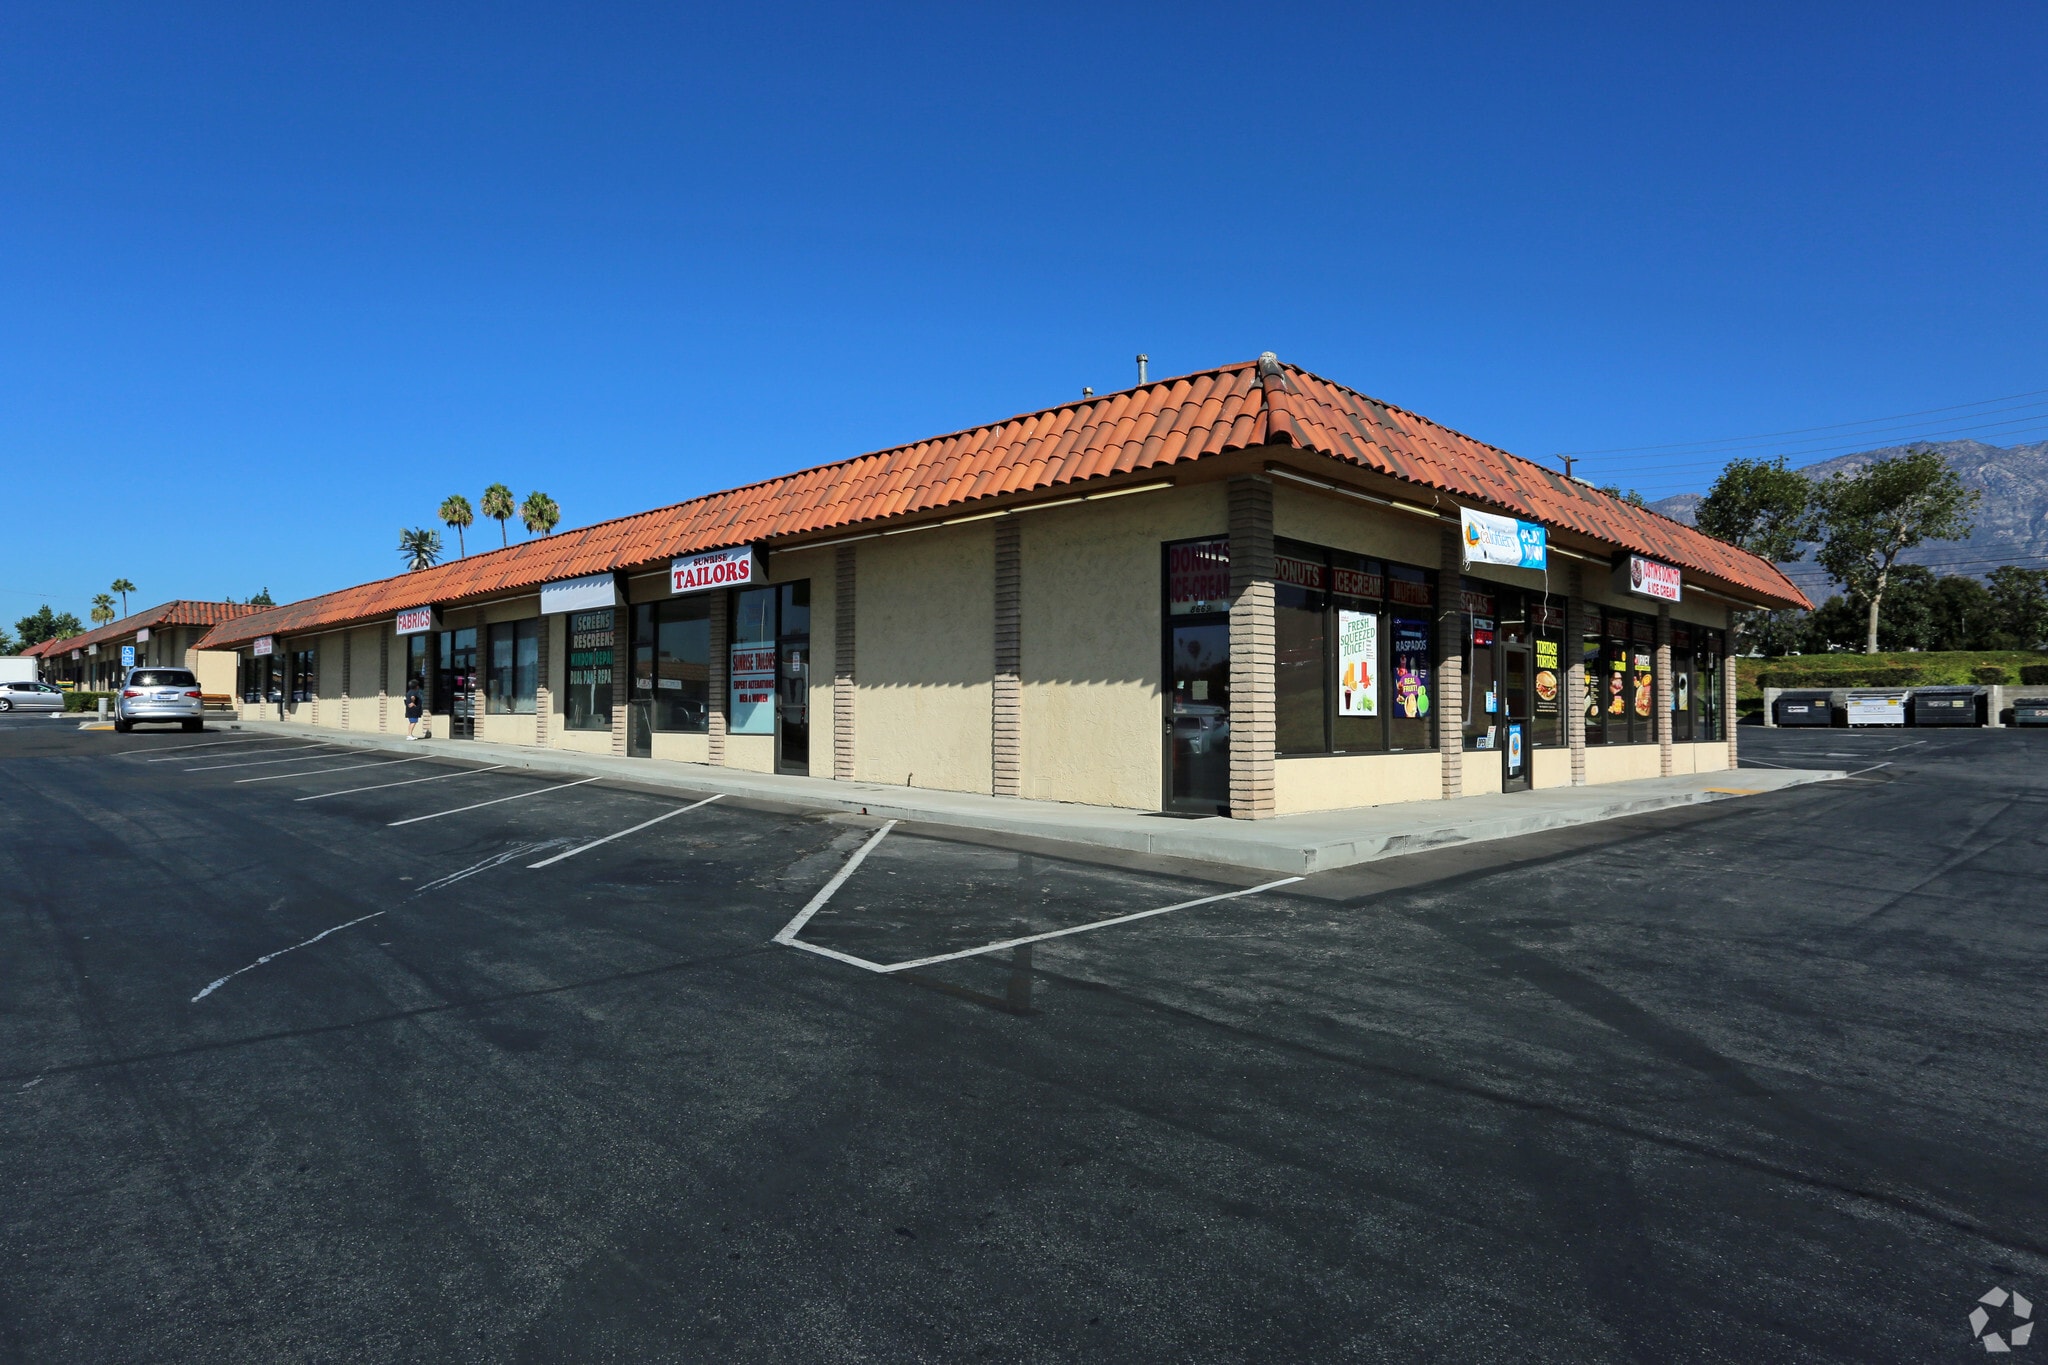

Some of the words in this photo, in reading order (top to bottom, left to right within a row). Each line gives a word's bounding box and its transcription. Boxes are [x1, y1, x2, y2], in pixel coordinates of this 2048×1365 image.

[1520, 529, 1541, 544] PLAY
[693, 553, 728, 567] SUNRISE
[1171, 543, 1230, 573] DONUTS
[1523, 544, 1543, 561] NOW
[673, 559, 750, 590] TAILORS
[1274, 558, 1319, 587] DONUTS
[1334, 571, 1381, 597] ICE-CREAM
[1393, 582, 1429, 603] MUFFINS
[1660, 584, 1676, 599] CREAM
[1460, 592, 1488, 613] SODAS
[398, 609, 429, 629] FABRICS
[577, 613, 610, 631] SCREENS
[1347, 618, 1369, 632] FRESH
[573, 632, 615, 649] RESCREENS
[1340, 627, 1376, 646] SQUEEZED
[1343, 641, 1365, 657] JUICE!
[1395, 640, 1427, 652] RASPADOS
[1536, 640, 1558, 655] TORTAS!
[595, 649, 614, 665] REPAI
[733, 654, 753, 671] SUNRISE
[756, 652, 776, 670] TAILORS
[1536, 654, 1558, 670] TORTAS!
[570, 670, 583, 685] DUAL
[597, 668, 612, 684] REPA
